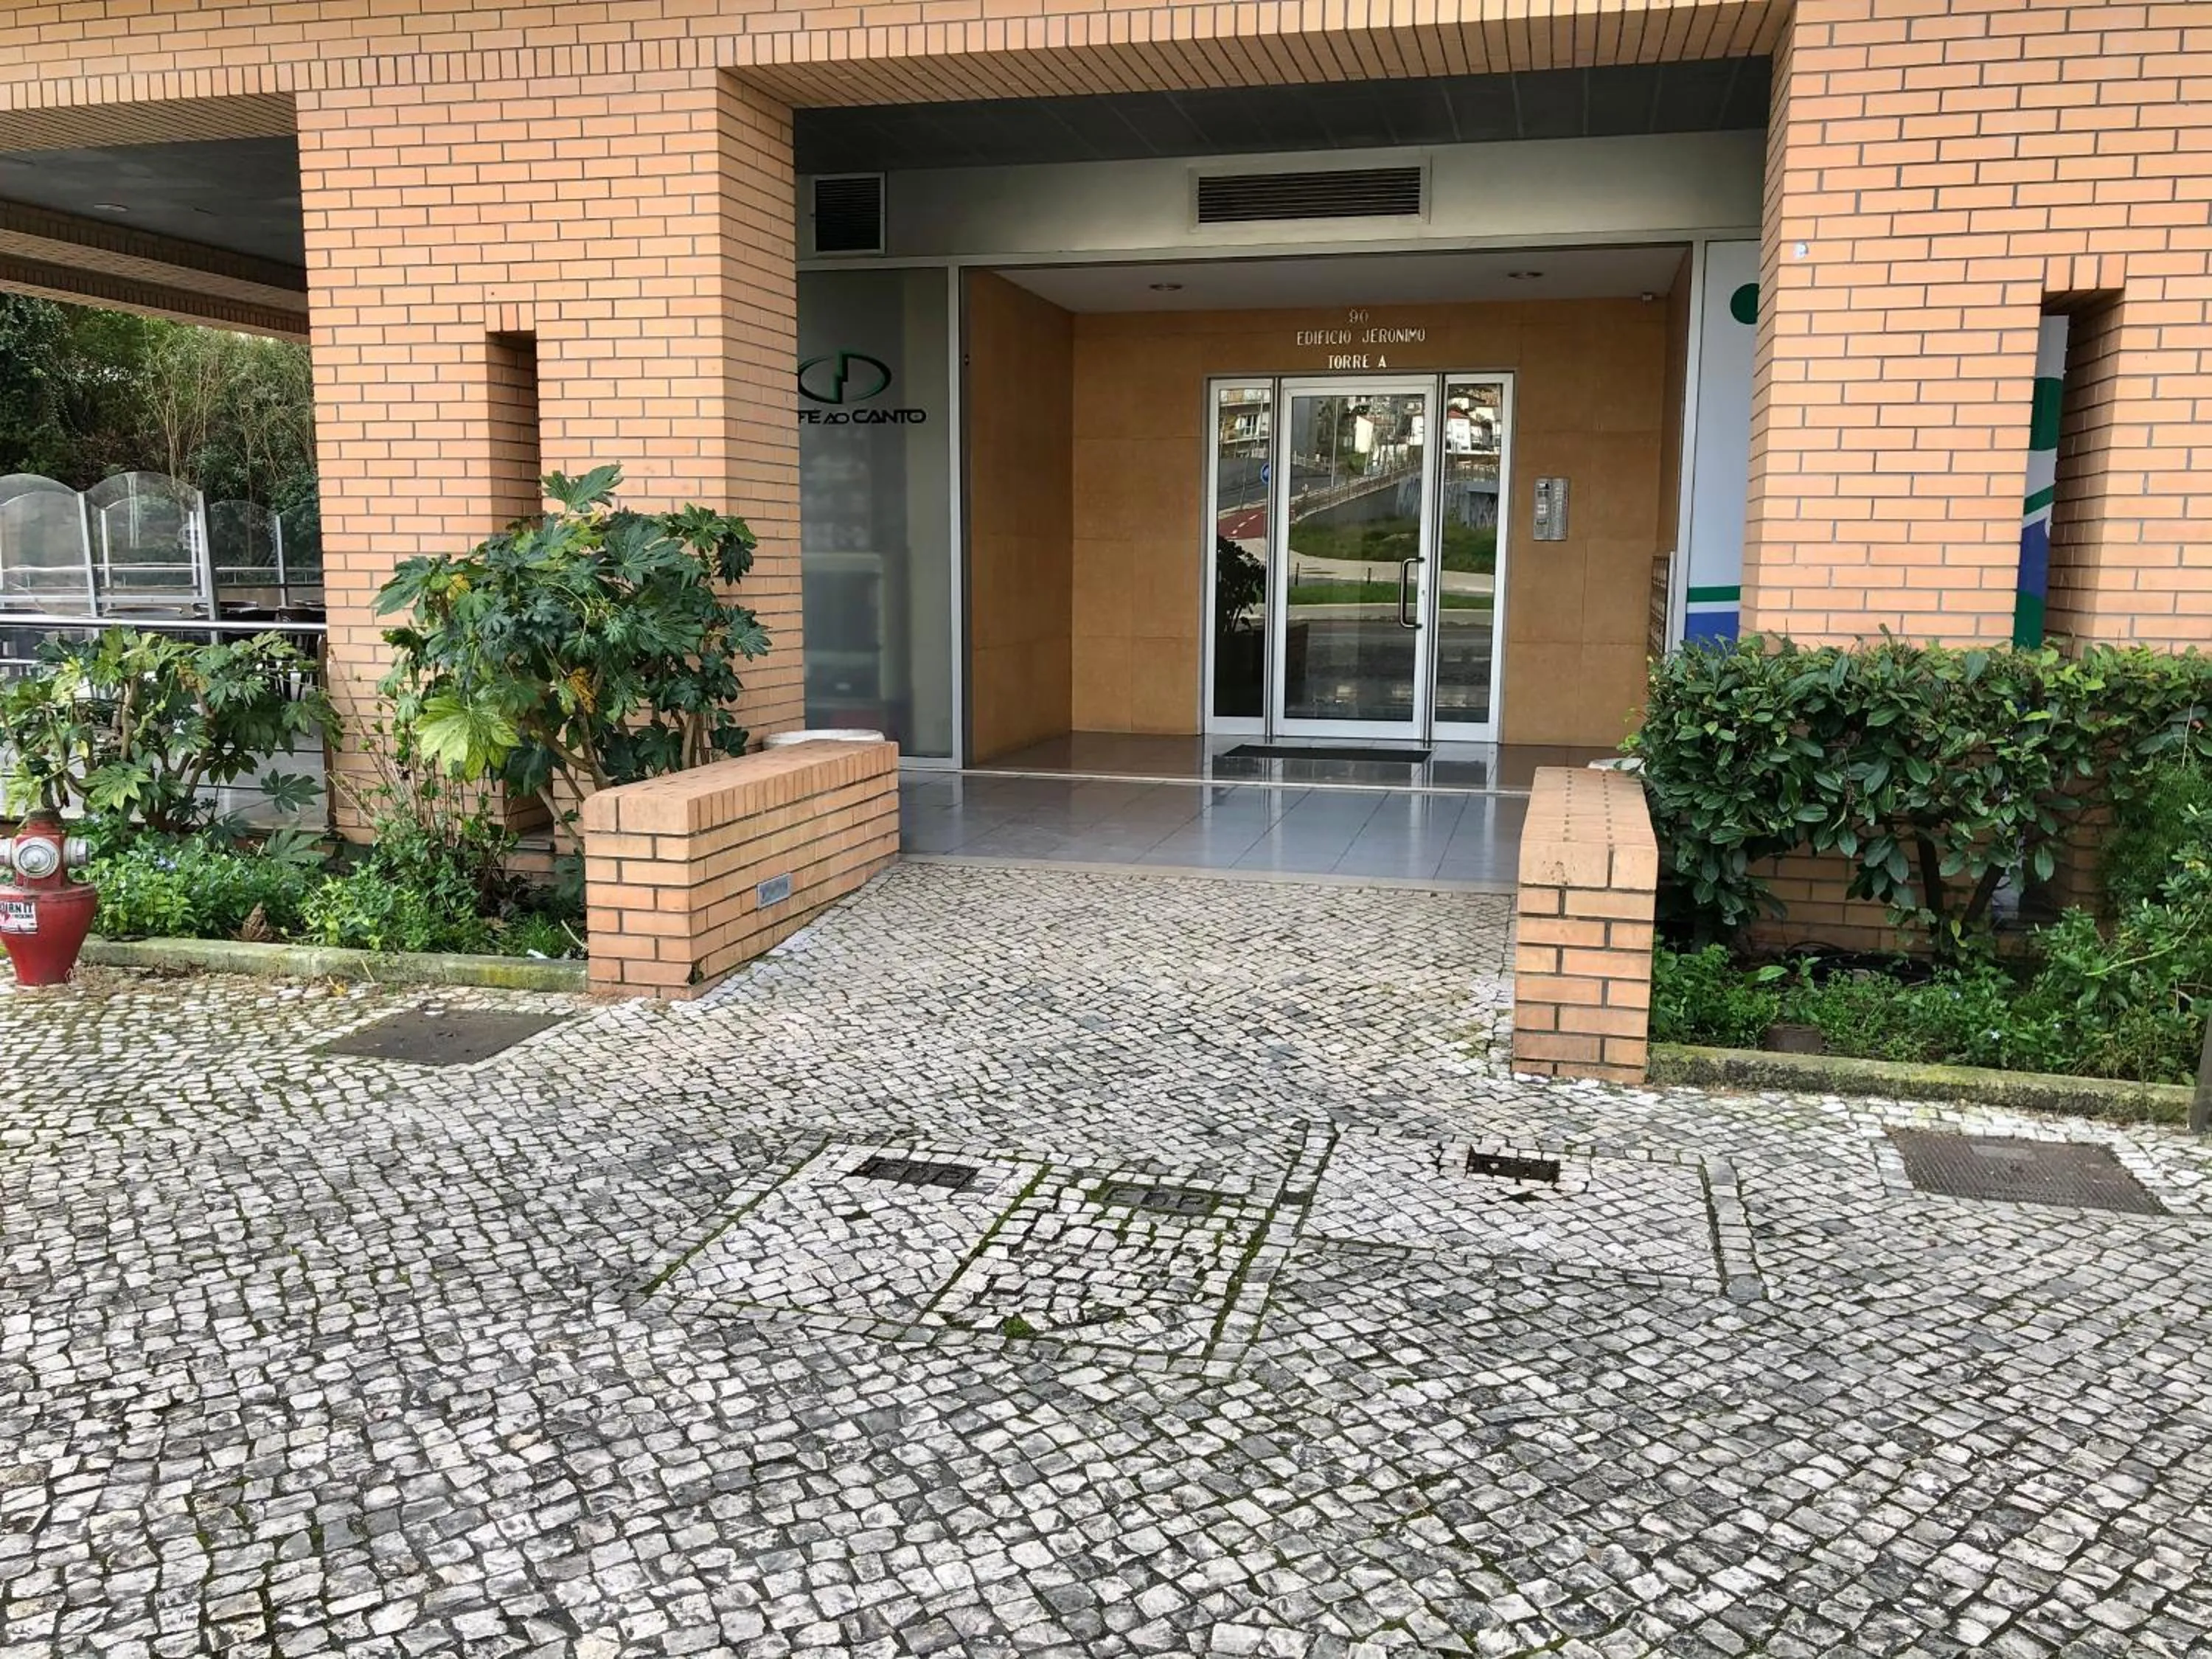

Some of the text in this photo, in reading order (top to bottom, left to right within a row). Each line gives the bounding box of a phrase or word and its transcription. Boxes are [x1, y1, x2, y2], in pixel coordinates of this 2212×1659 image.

[1349, 308, 1369, 324] 90
[1297, 328, 1425, 345] EDIFICIO JERONIMO
[1328, 354, 1388, 369] TORRE A
[823, 412, 849, 425] AO
[852, 408, 927, 424] CANTO
